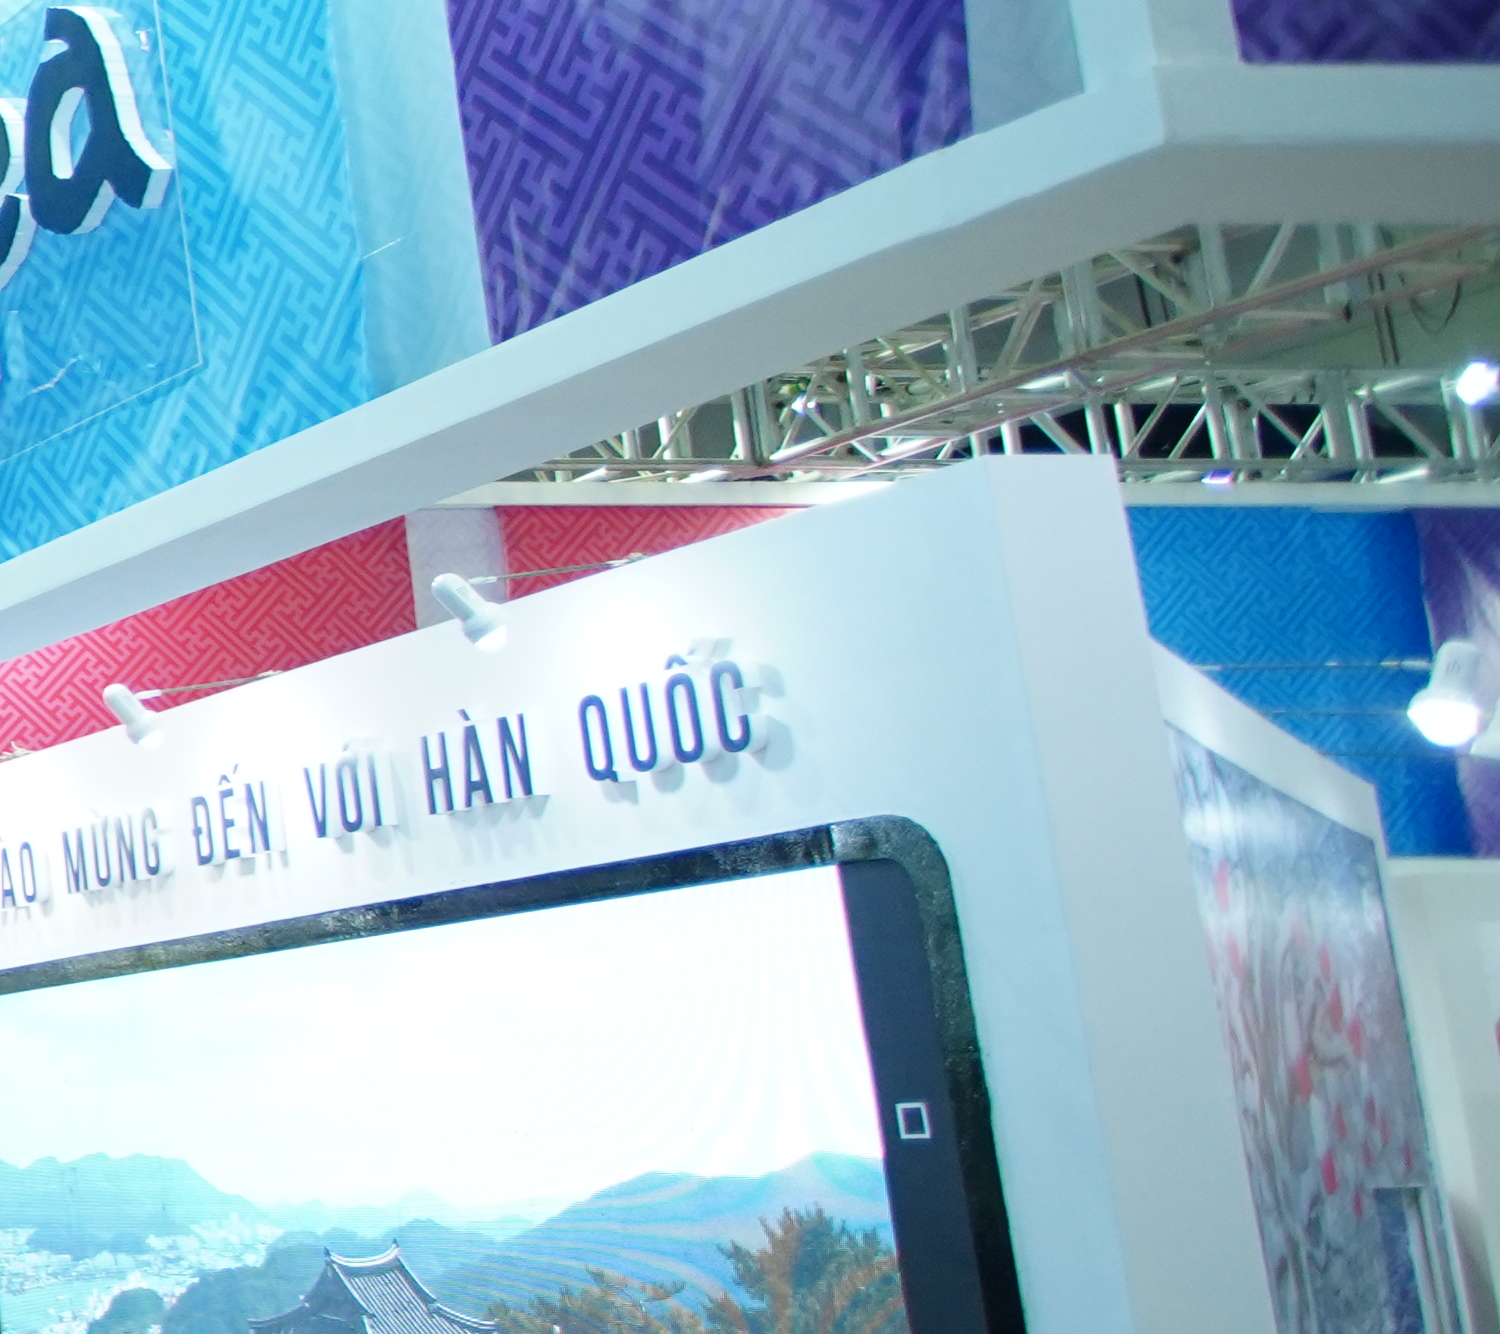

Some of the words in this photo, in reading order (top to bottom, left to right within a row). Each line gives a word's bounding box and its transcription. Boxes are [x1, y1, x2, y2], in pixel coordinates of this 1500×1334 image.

[189, 761, 269, 867] ĐẾN
[303, 744, 384, 841] VỚI
[421, 707, 537, 816] HÀN
[578, 655, 754, 784] QUỐC
